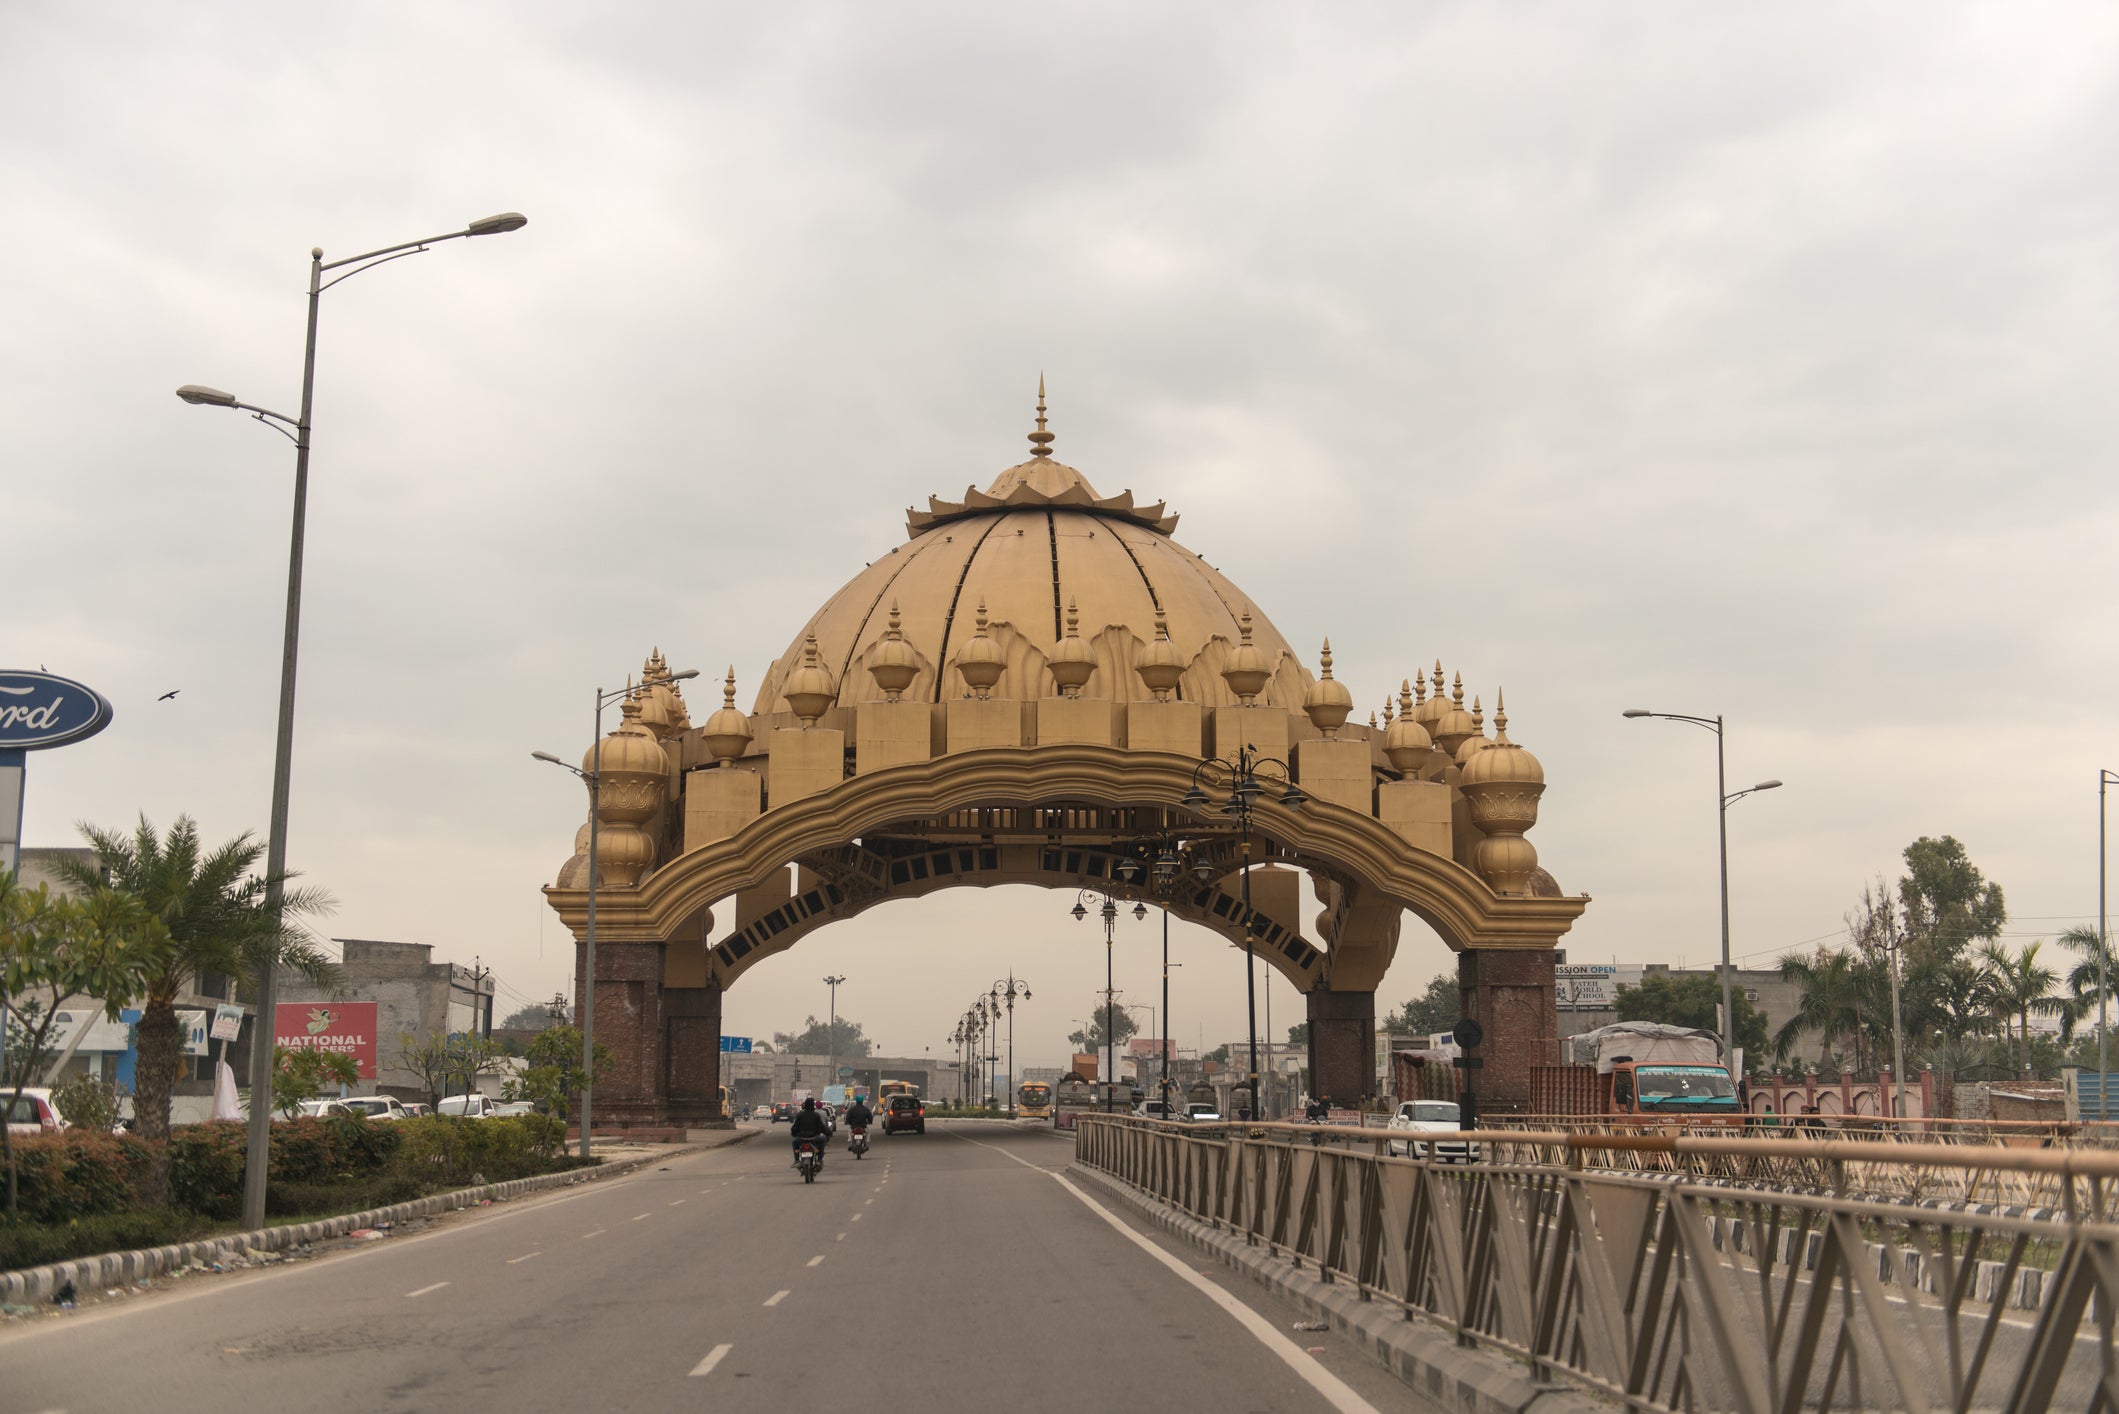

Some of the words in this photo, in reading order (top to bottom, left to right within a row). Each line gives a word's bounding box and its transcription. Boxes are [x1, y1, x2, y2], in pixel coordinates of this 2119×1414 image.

[0, 697, 64, 729] rd
[277, 1035, 367, 1047] NATIONAL
[288, 1046, 355, 1054] BULDERS
